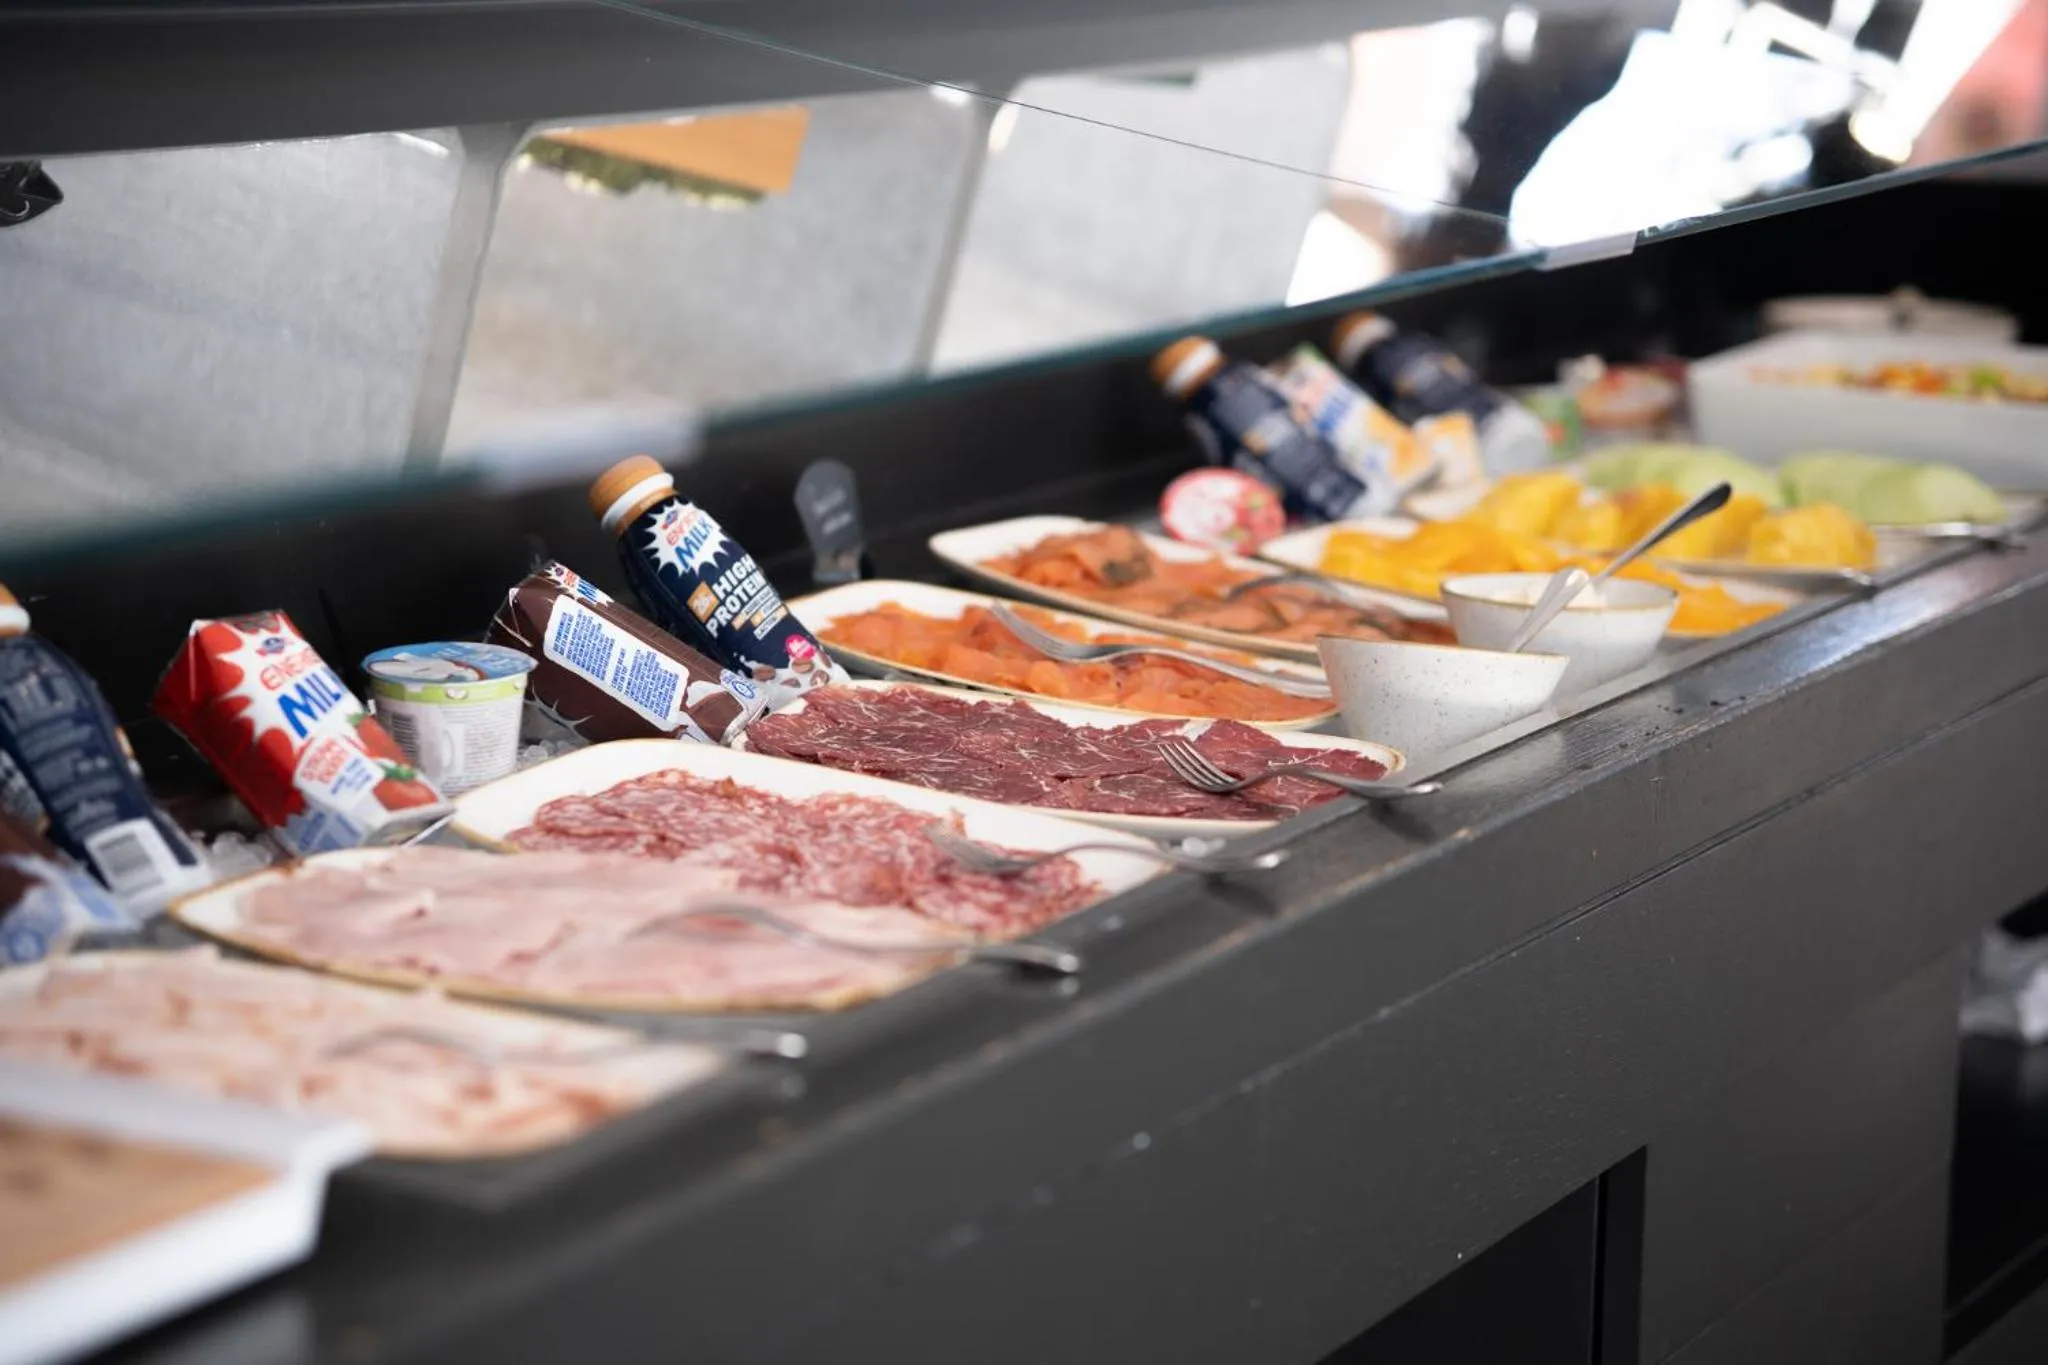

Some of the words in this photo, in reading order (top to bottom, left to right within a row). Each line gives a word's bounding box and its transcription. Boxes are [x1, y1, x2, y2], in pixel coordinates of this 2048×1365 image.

[674, 517, 714, 573] MILK
[711, 553, 757, 599] HIGH
[705, 570, 769, 639] PROTEIN
